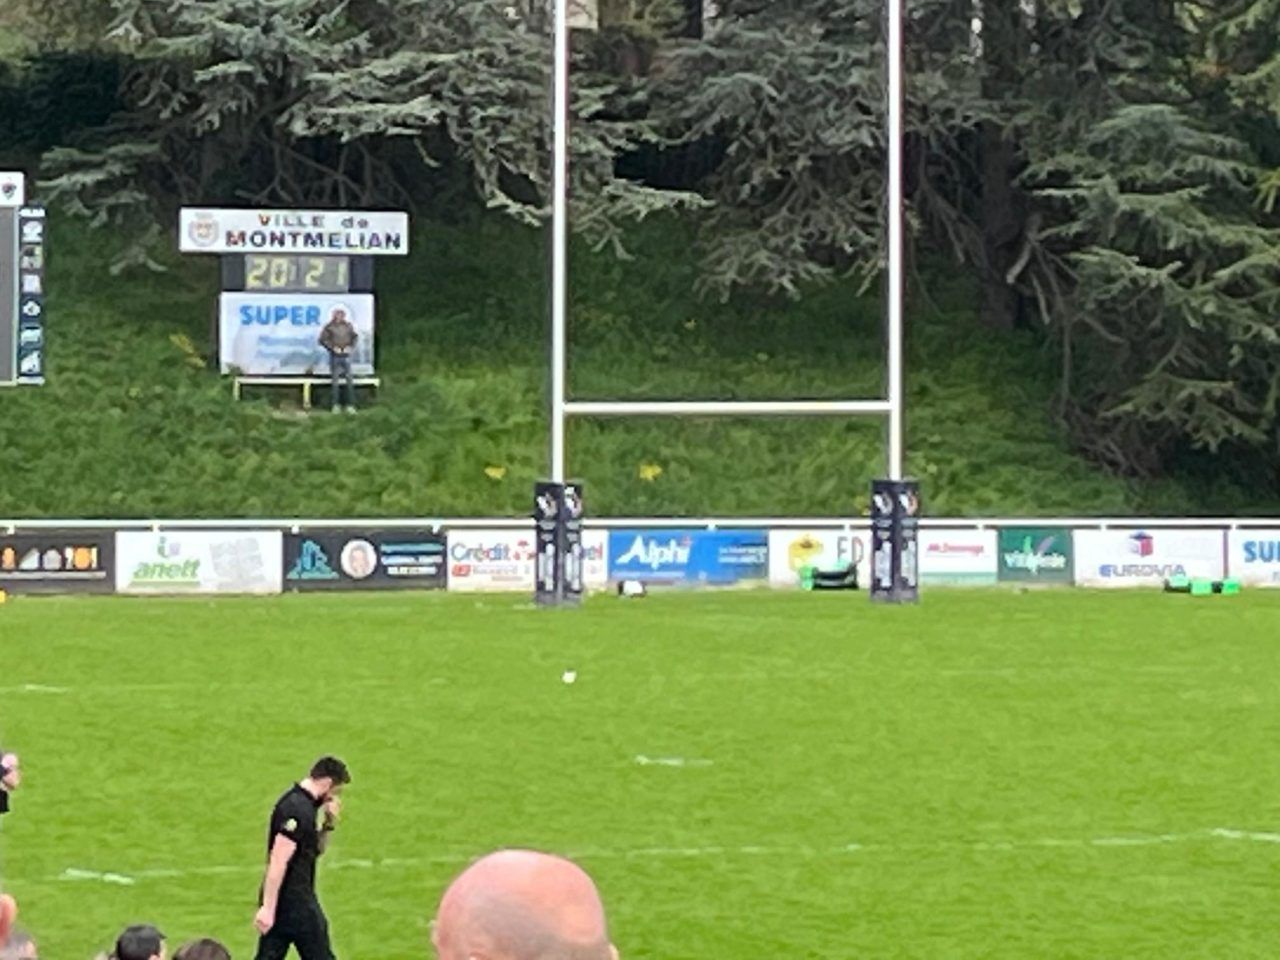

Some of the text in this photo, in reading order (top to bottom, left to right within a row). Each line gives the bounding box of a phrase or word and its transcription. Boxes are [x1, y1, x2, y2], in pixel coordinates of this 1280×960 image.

[259, 214, 369, 228] VILLE de
[225, 230, 401, 250] MONTMELIAN
[240, 305, 320, 325] SUPER
[615, 535, 690, 570] Alphi
[1243, 540, 1280, 563] SU
[1099, 564, 1186, 578] EUROVIA
